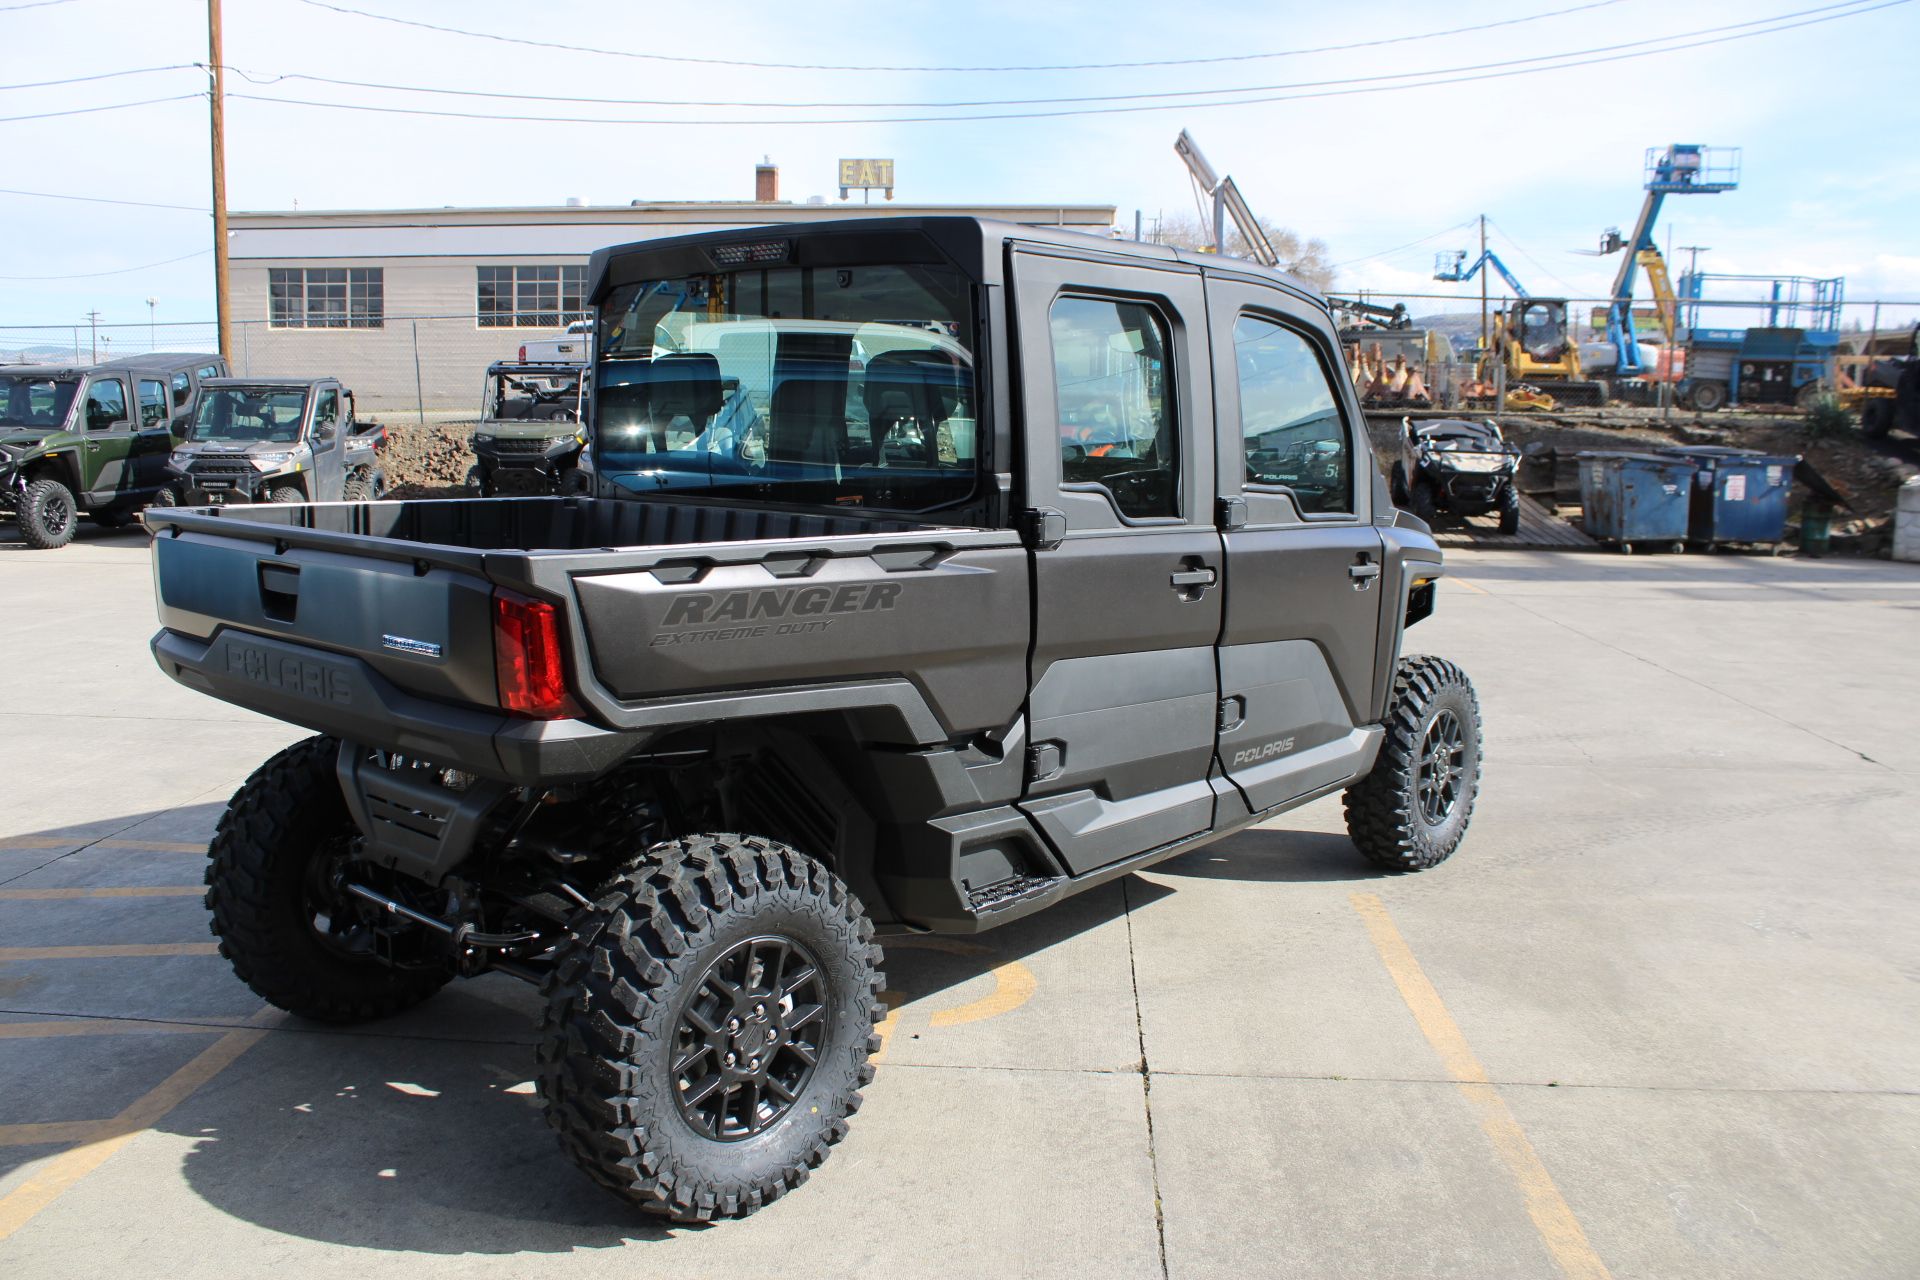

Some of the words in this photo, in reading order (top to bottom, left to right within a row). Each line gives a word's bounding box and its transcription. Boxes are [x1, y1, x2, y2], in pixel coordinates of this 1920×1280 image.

[841, 160, 894, 185] EAT
[659, 581, 903, 628] RANGER
[649, 626, 769, 647] EXTREME
[776, 618, 834, 636] DUTY
[225, 643, 352, 704] POLARIS
[1233, 736, 1296, 766] POLARIS
